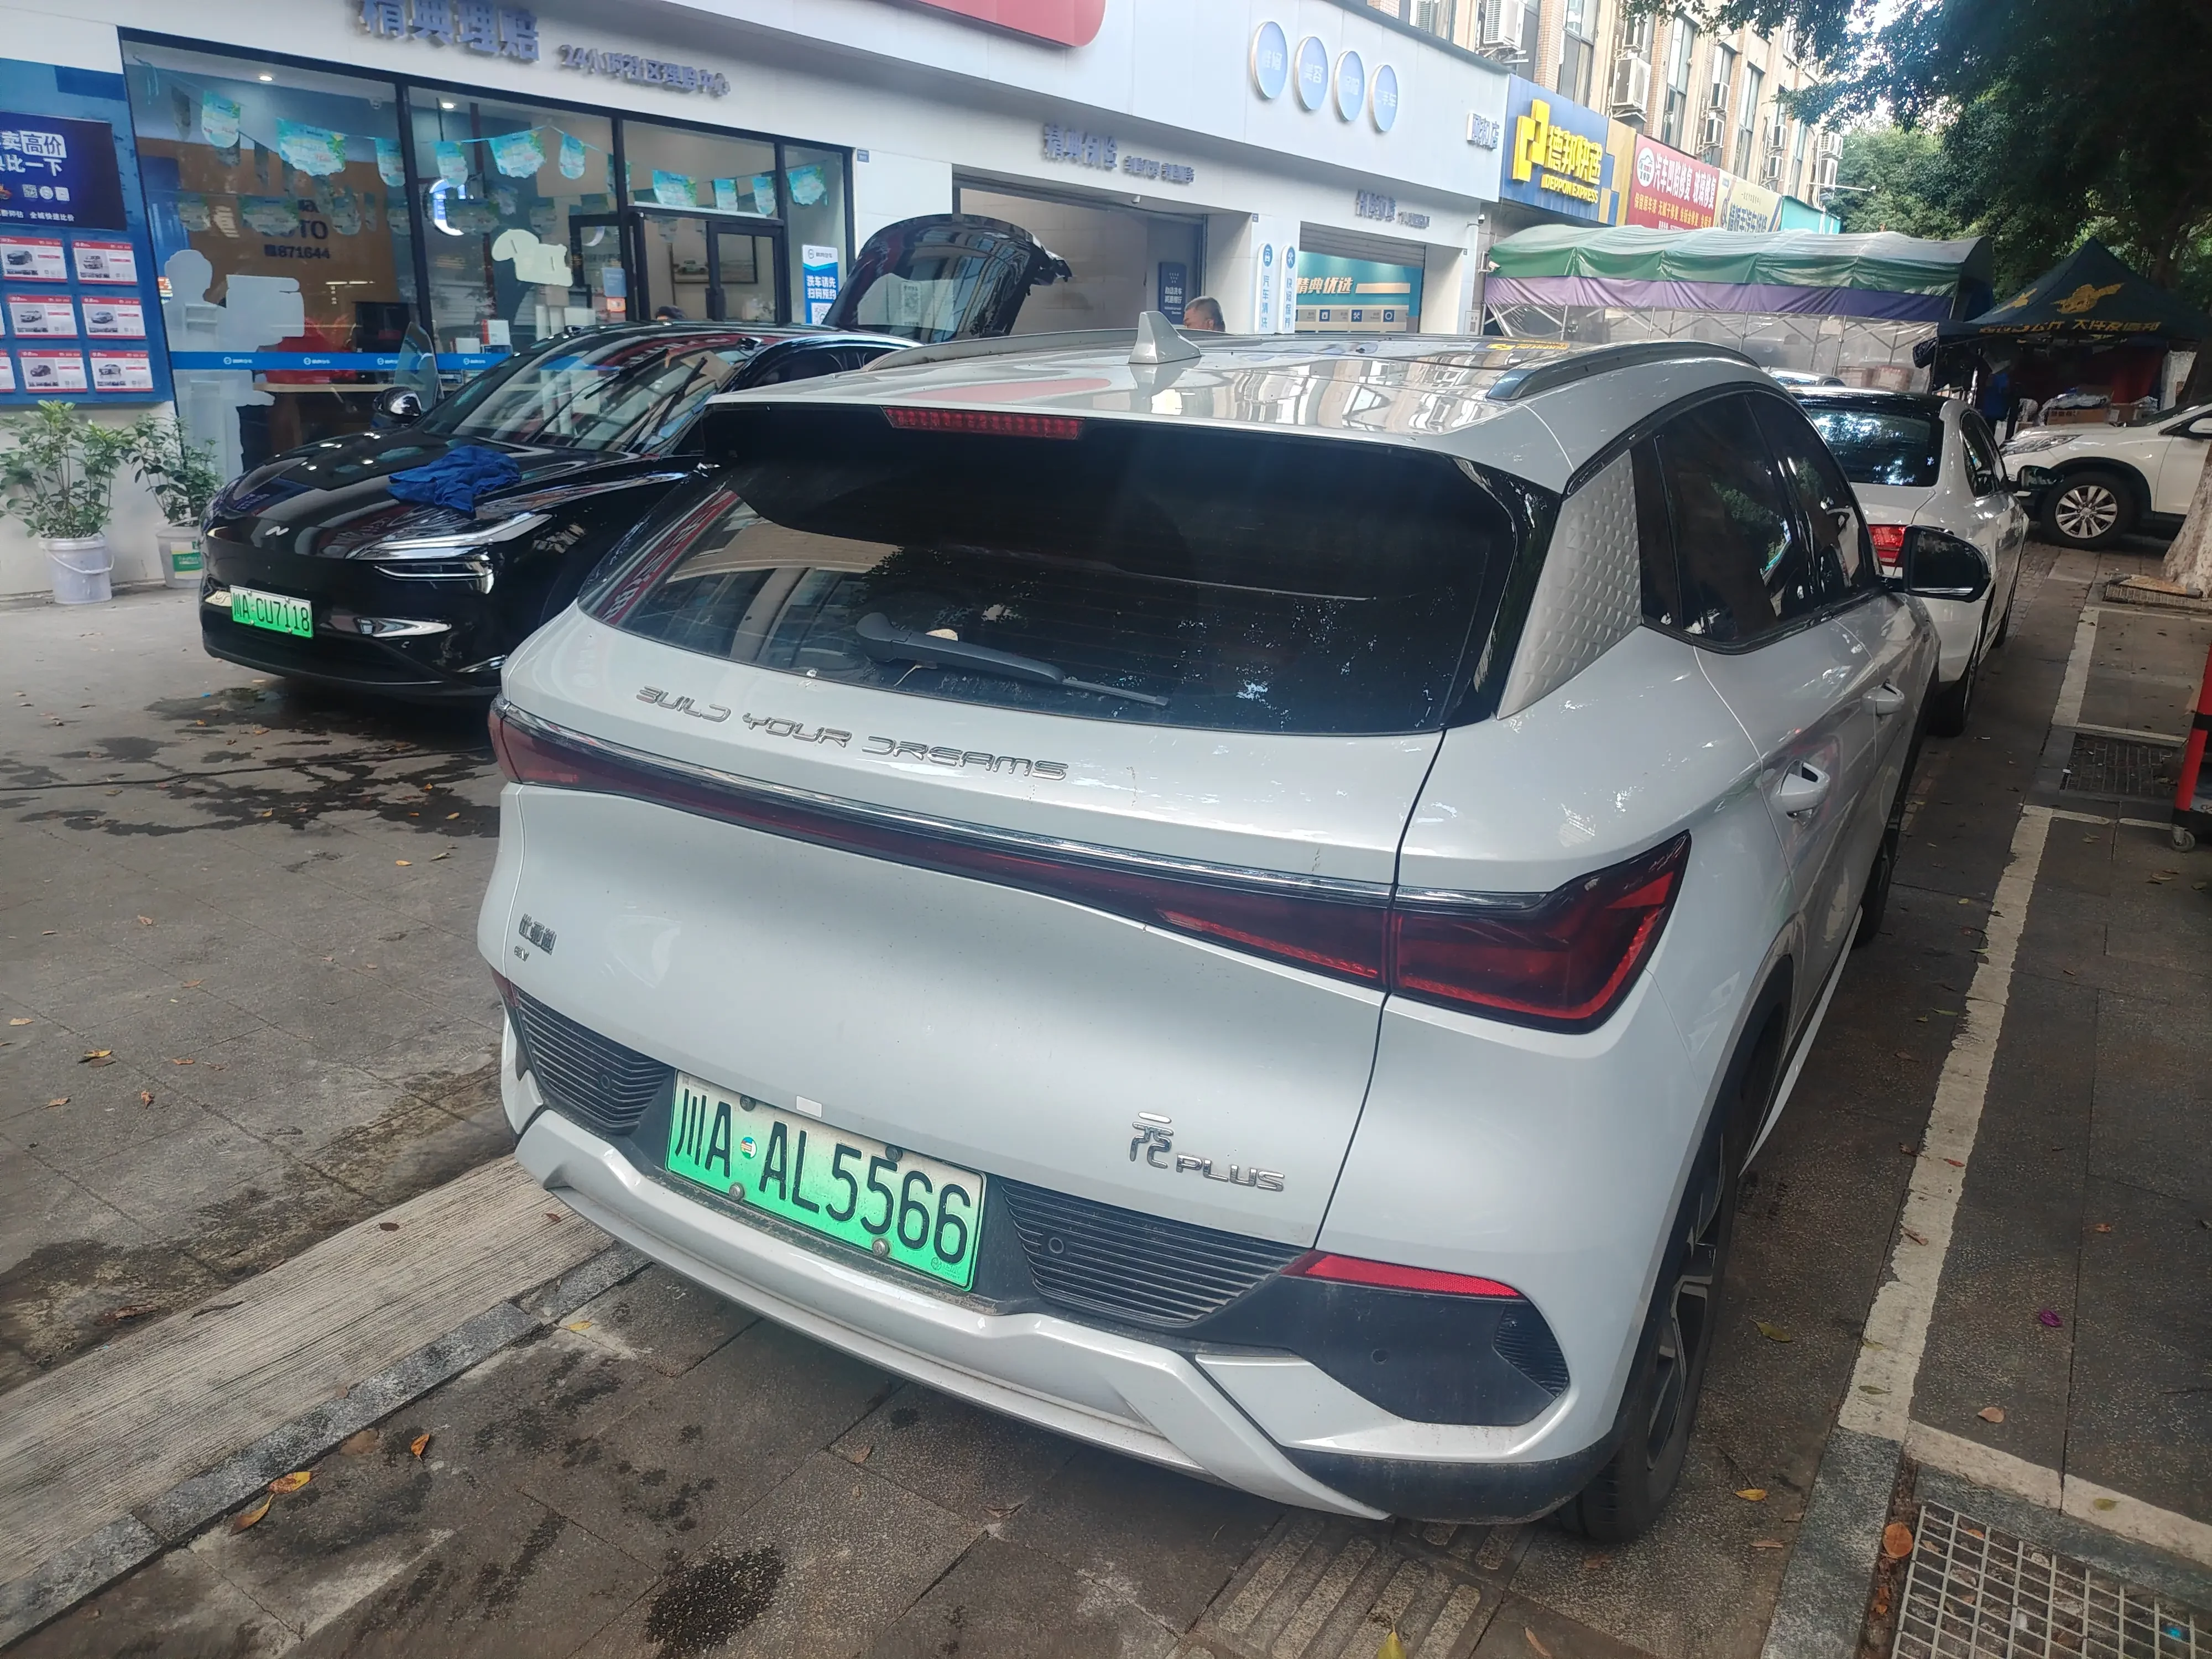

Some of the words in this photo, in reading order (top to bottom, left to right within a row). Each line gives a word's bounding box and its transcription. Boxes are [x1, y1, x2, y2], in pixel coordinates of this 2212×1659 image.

[0, 154, 62, 176] 比一下
[1545, 125, 1603, 185] 德邦快递
[1541, 174, 1572, 195] DEPPON
[1572, 184, 1598, 204] EXPRESS
[1653, 153, 1693, 202] 汽车凹陷修复
[1692, 168, 1717, 210] 玻璃修复
[278, 244, 330, 259] 871644
[806, 275, 836, 288] 洗车请先
[807, 288, 837, 300] 扫码预约
[1297, 277, 1353, 294] 精典优选
[636, 685, 732, 723] BUILD
[742, 711, 852, 748] YOUR
[861, 735, 1069, 781] DREAMS
[1130, 1111, 1174, 1169] 元
[1176, 1154, 1285, 1192] PLUS
